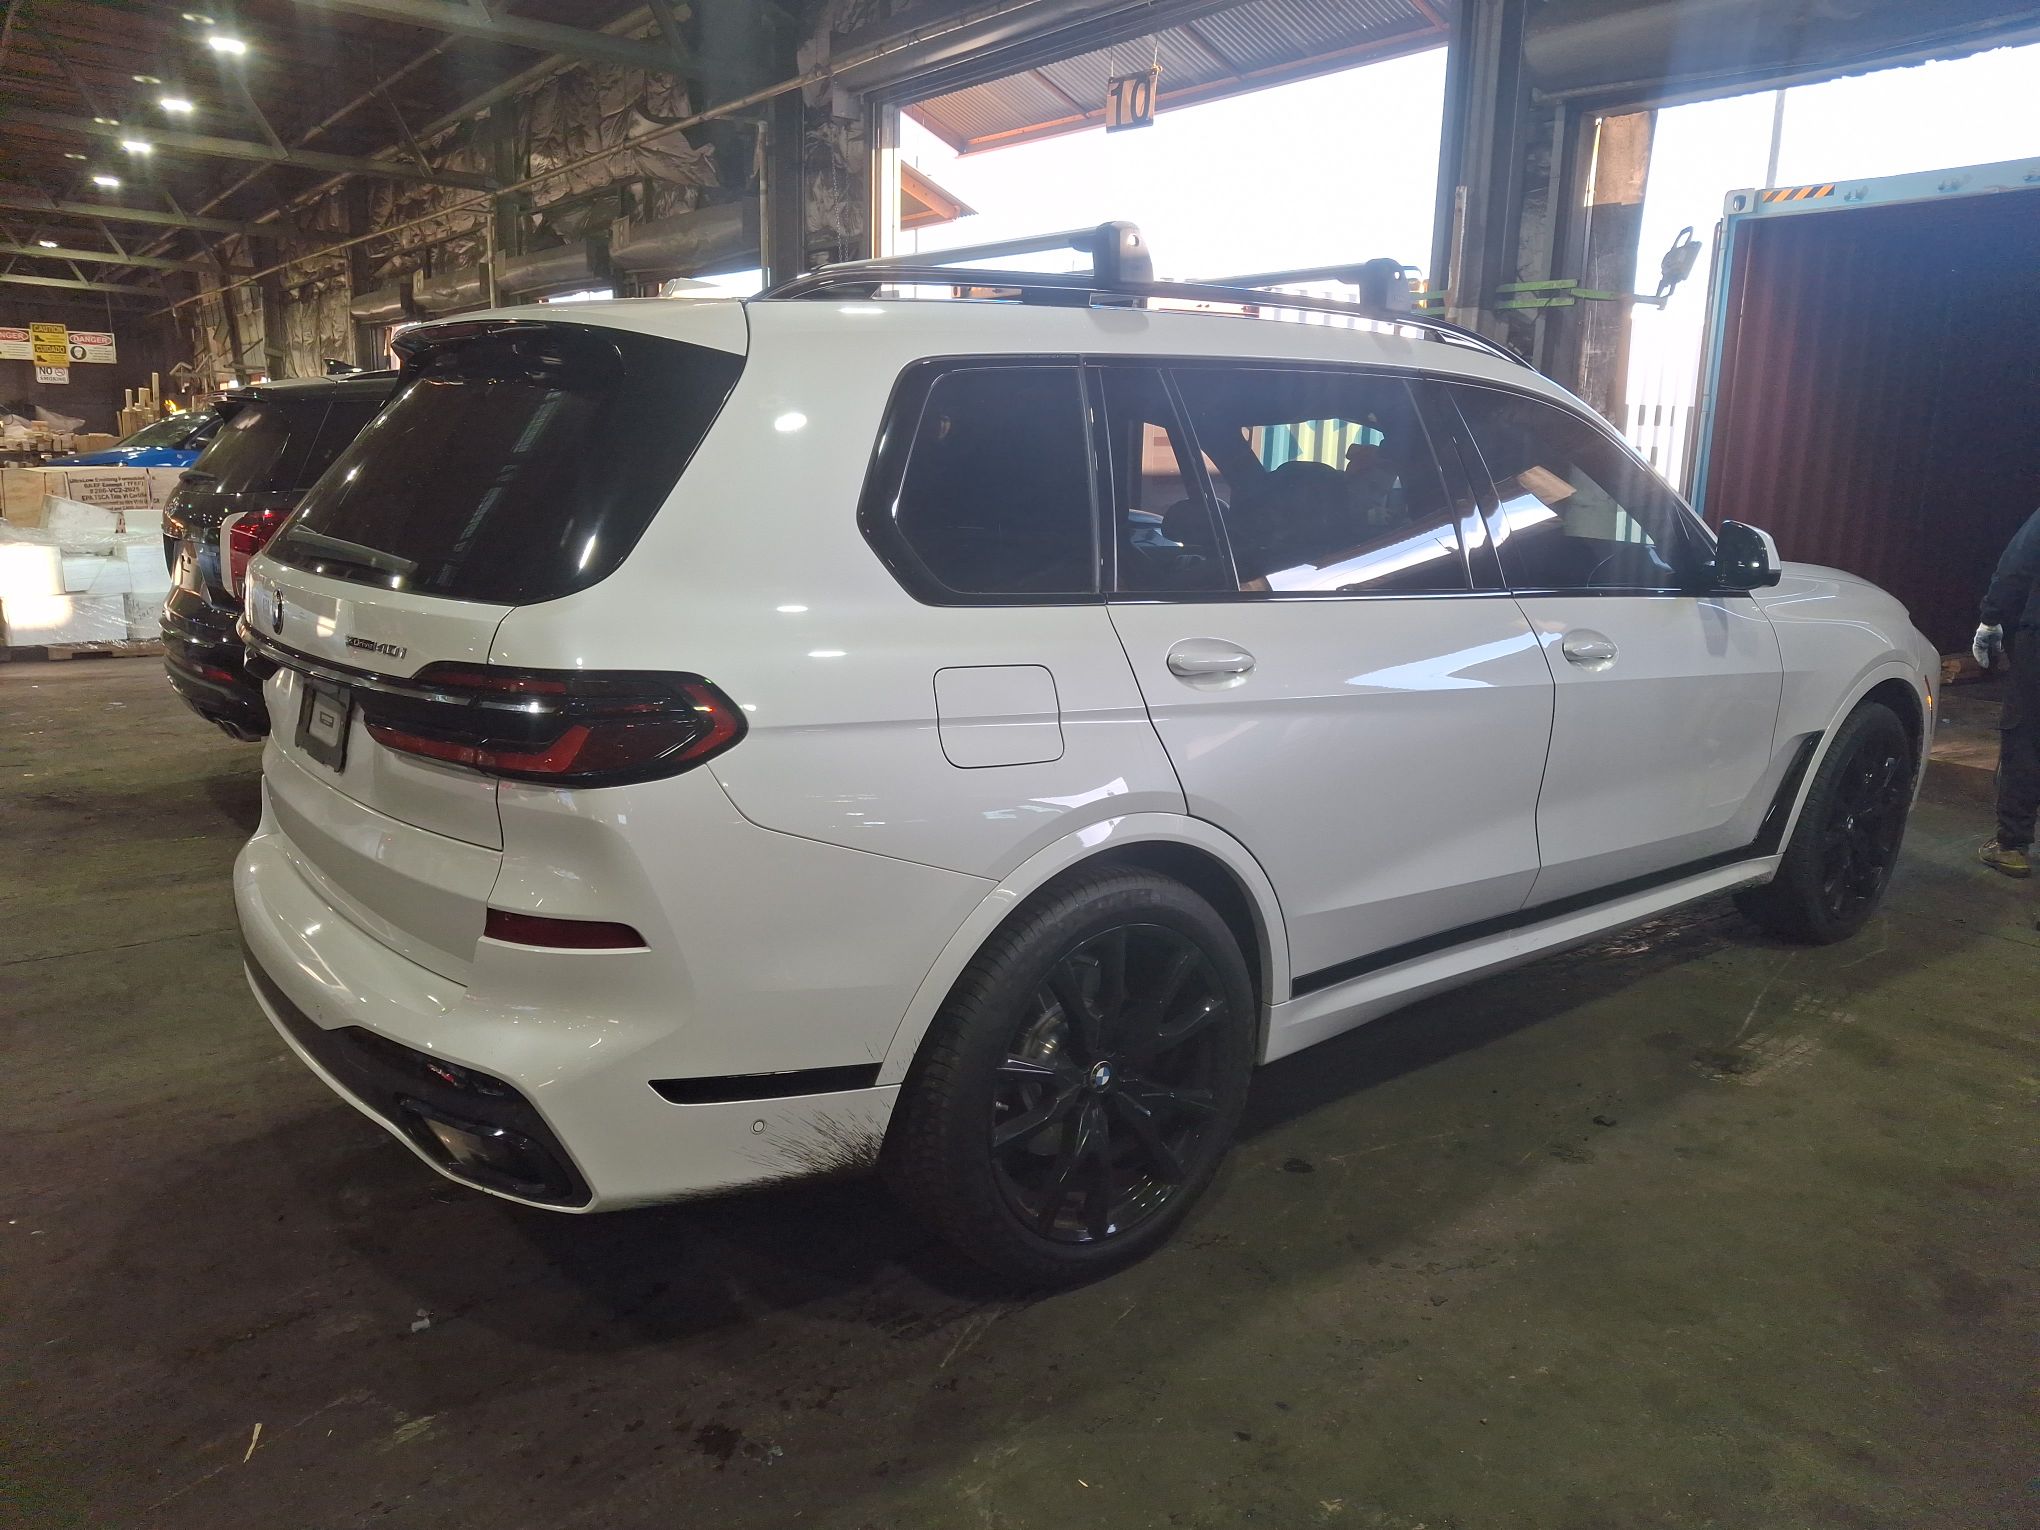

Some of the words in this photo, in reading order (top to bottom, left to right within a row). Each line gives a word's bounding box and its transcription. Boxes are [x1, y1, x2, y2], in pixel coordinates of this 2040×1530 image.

[1111, 79, 1150, 125] 10
[73, 336, 108, 344] DANGER
[36, 345, 65, 353] CUIDADO
[39, 367, 53, 375] NO
